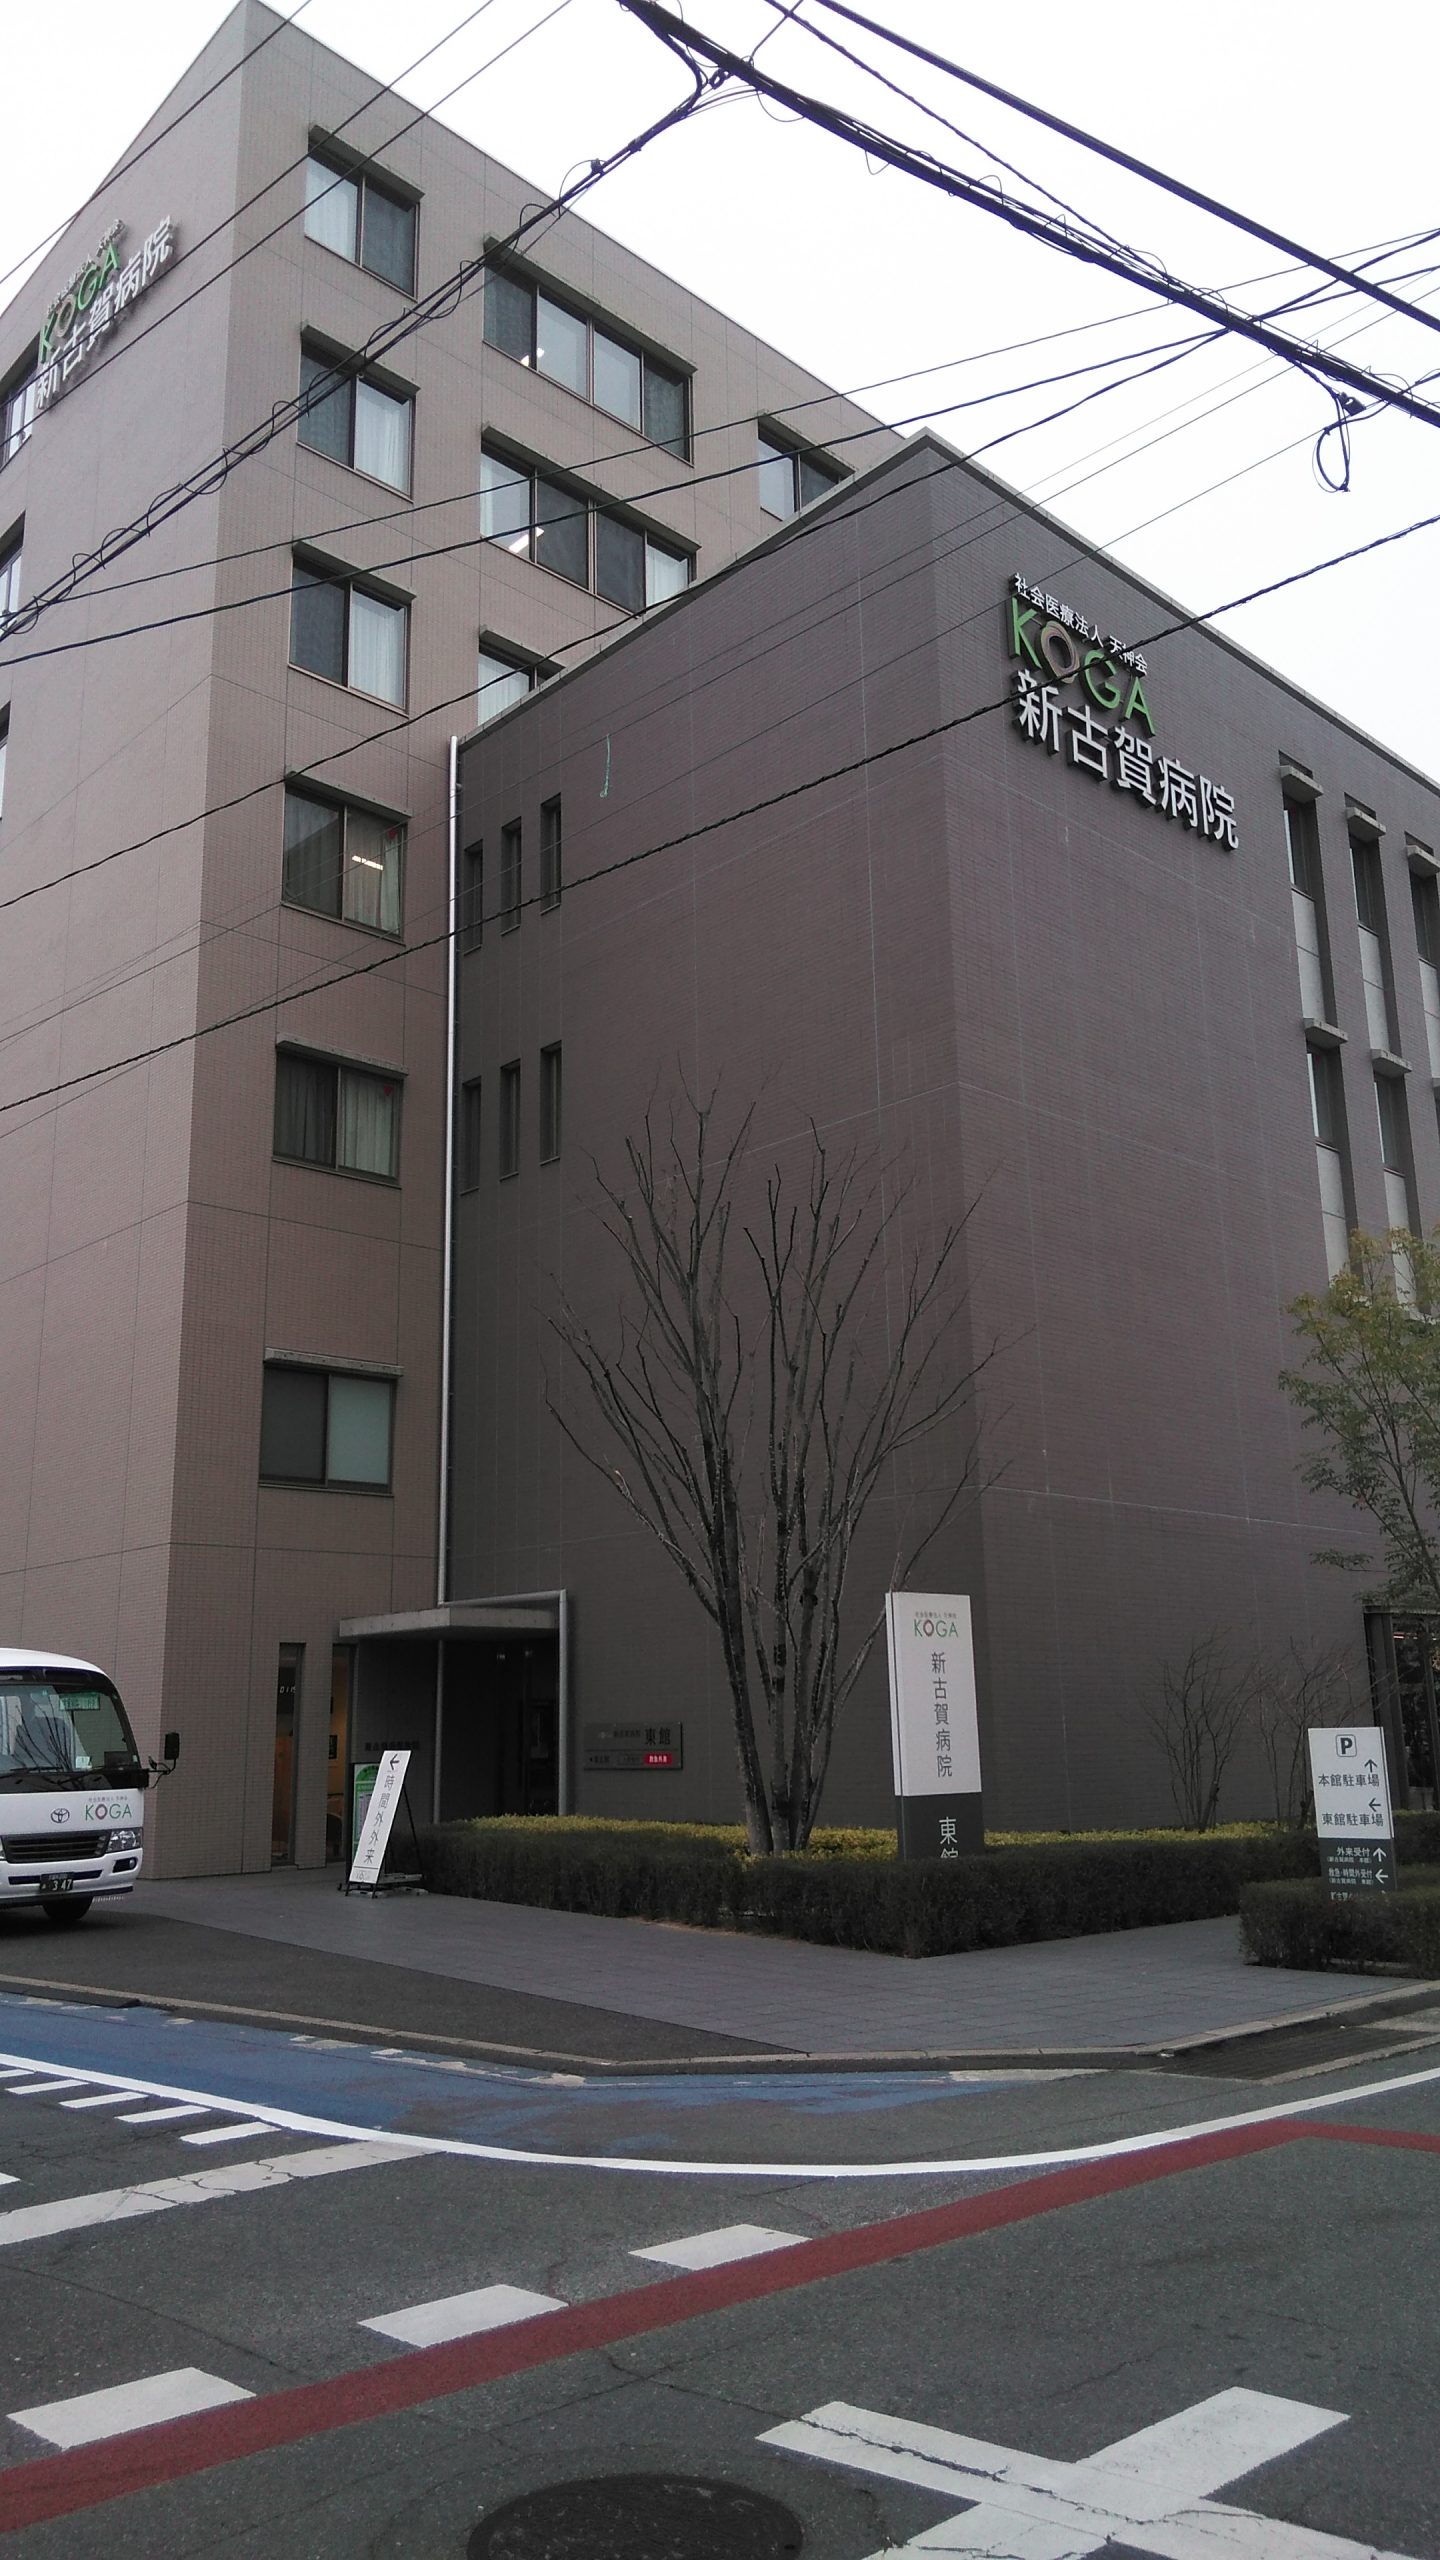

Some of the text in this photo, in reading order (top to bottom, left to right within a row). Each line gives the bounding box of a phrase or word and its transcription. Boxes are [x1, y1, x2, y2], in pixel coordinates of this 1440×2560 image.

[36, 214, 174, 409] 新古賀病院
[39, 242, 121, 363] KOGA
[1013, 572, 1104, 648] 社会医療法人
[1010, 596, 1157, 738] KOGA
[1015, 668, 1239, 850] 新古賀病院
[913, 1619, 959, 1638] KOGA
[931, 1651, 953, 1778] 新古賀病院
[1340, 1737, 1353, 1755] P
[1318, 1773, 1380, 1787] 本館駐車場
[85, 1803, 132, 1821] KOGA
[1322, 1813, 1384, 1827] 東館駐車場
[1336, 1846, 1371, 1857] 外来受付
